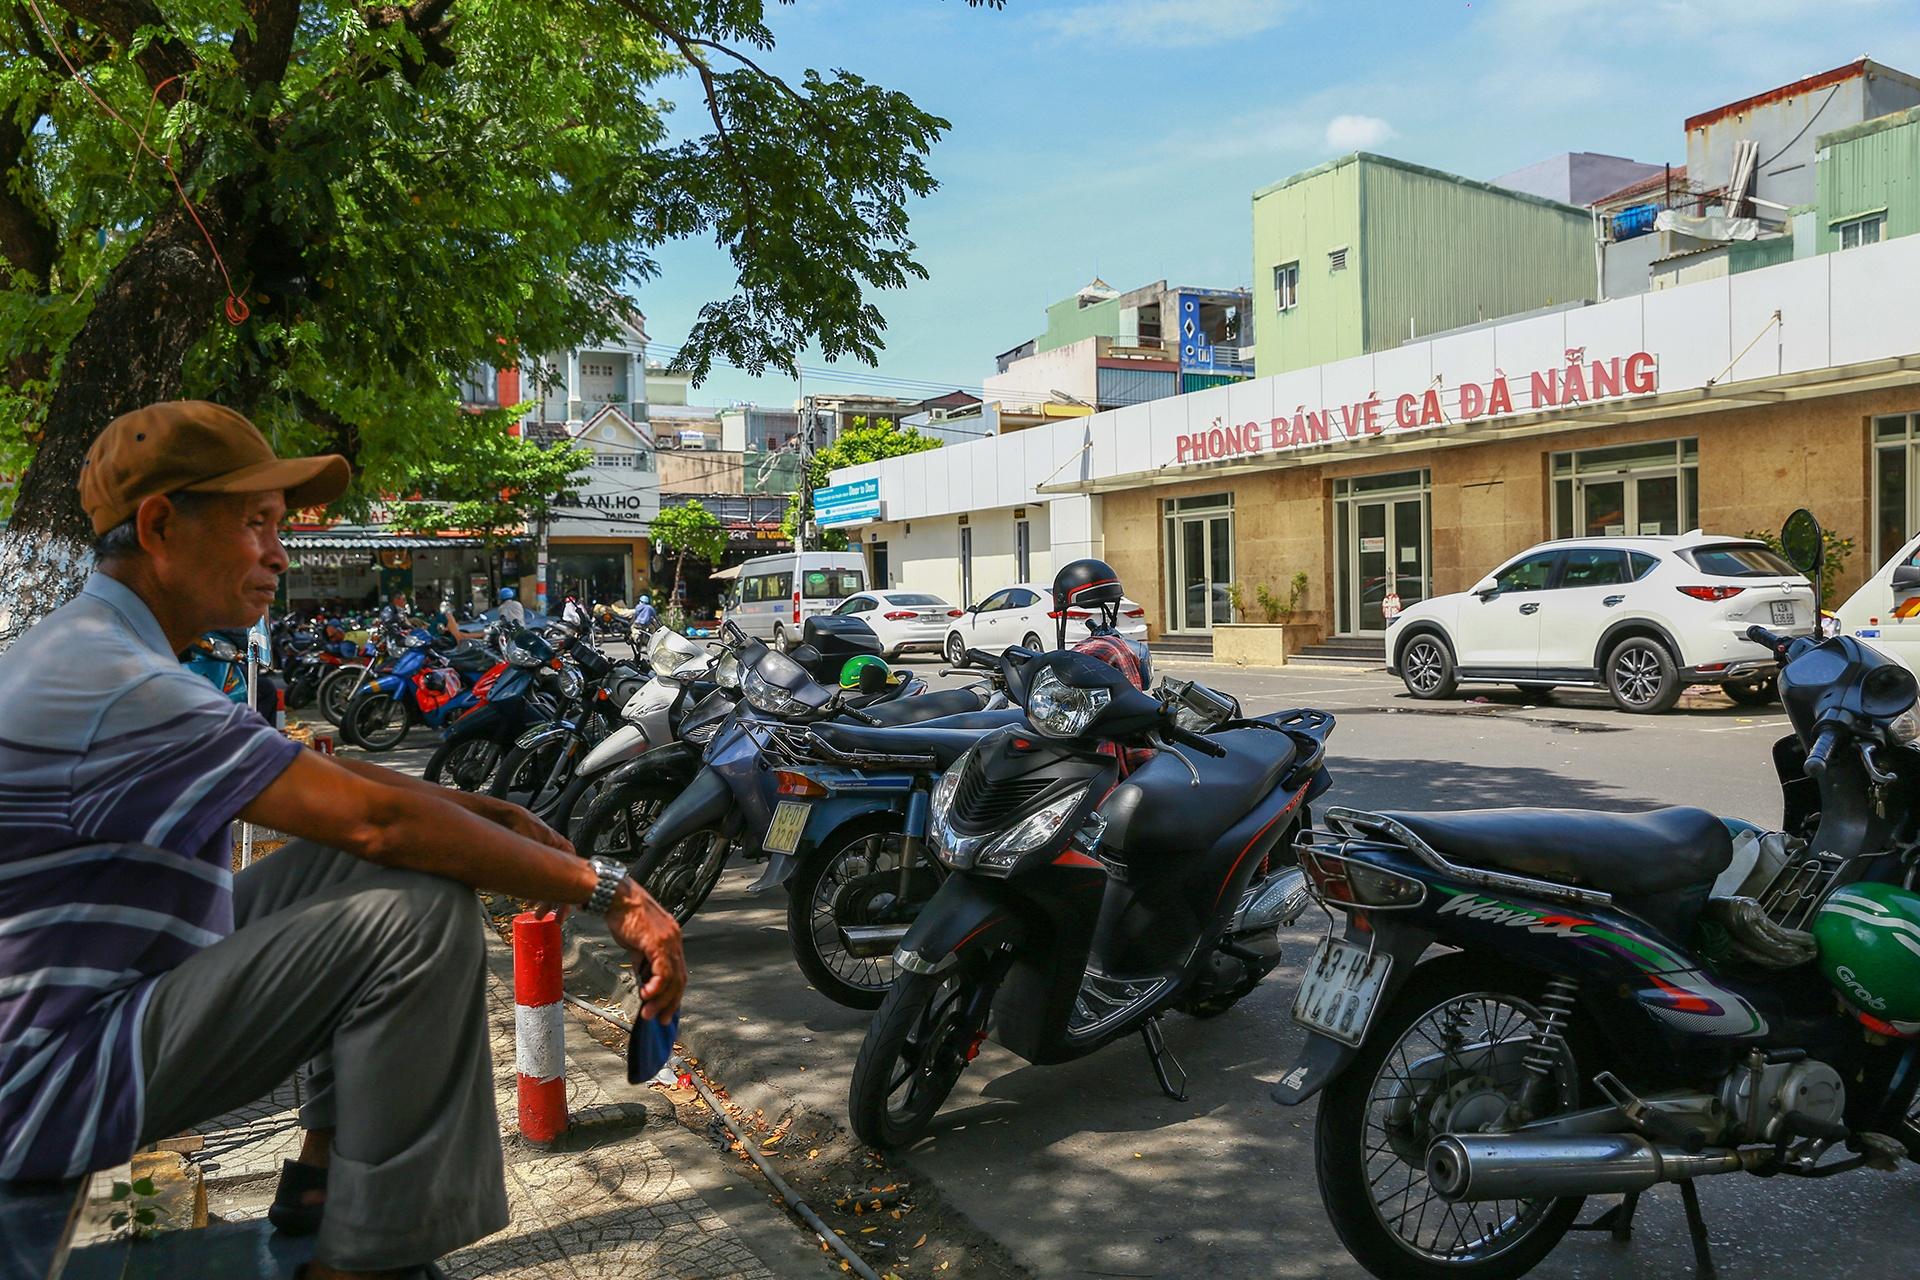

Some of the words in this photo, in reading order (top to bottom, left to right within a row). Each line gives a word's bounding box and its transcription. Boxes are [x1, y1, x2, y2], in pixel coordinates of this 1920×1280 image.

[1176, 420, 1260, 463] PHÒNG
[1271, 405, 1329, 448] BÁN
[1341, 391, 1382, 436] VÉ
[1459, 368, 1515, 419] ĐÀ
[1436, 893, 1544, 926] Wave
[1836, 965, 1887, 1010] Grab
